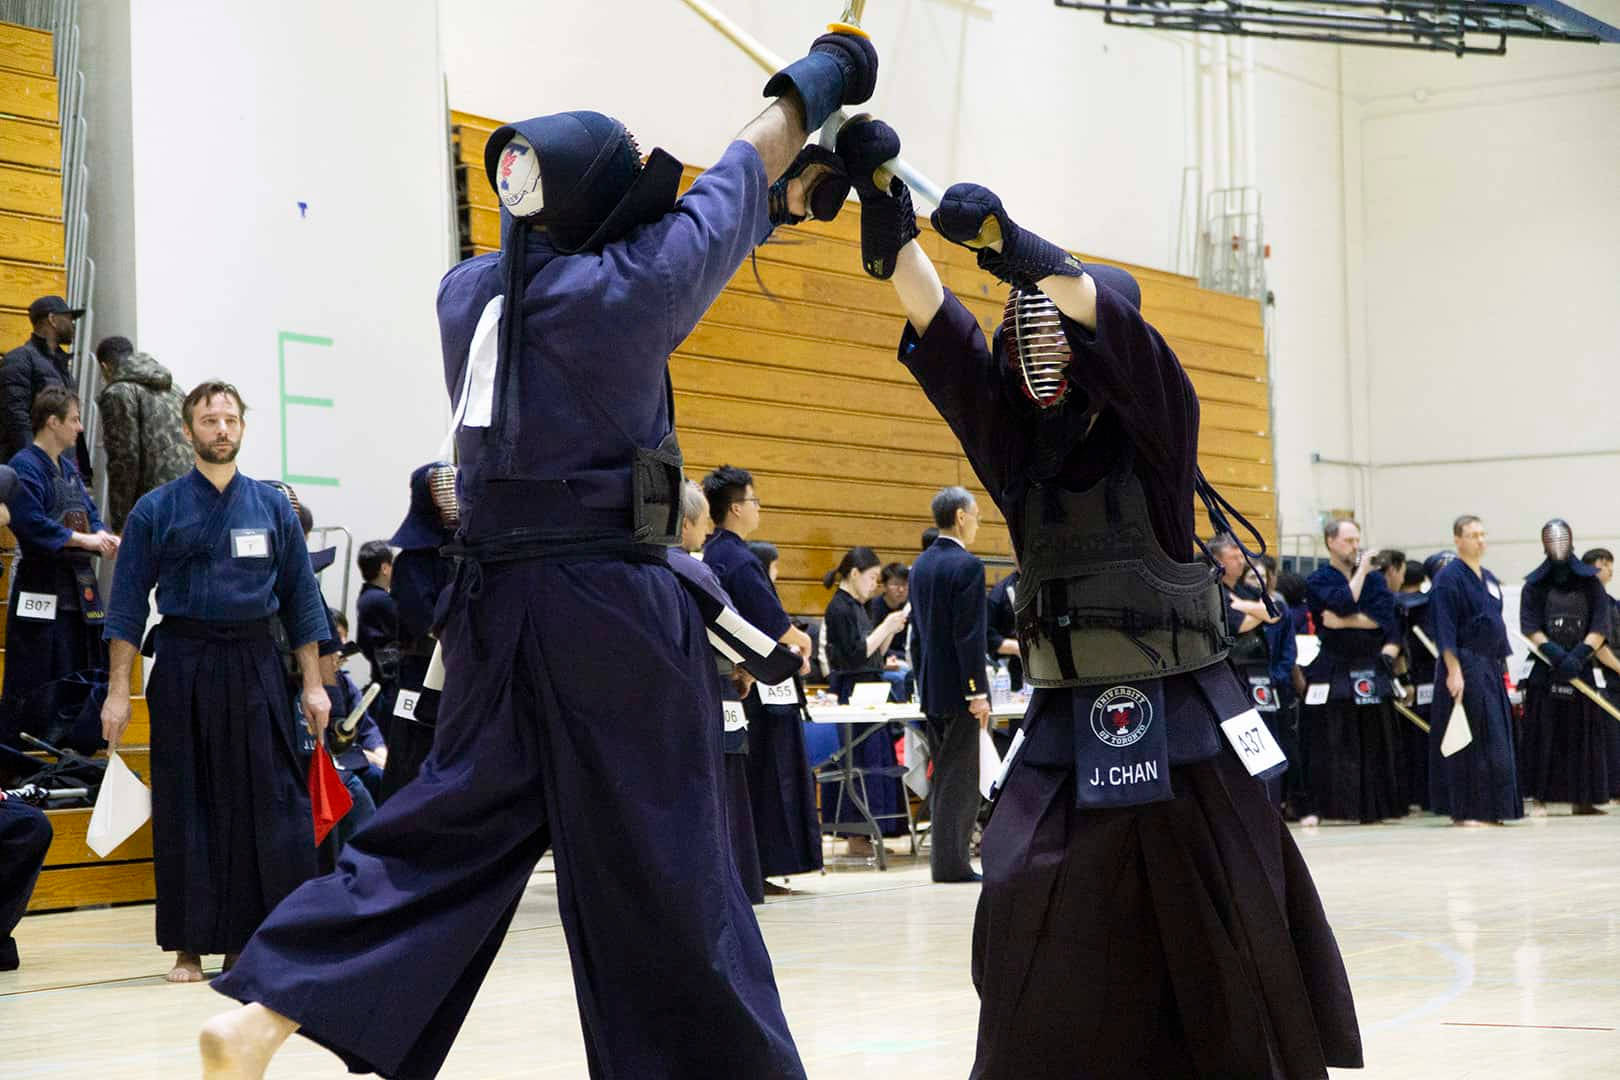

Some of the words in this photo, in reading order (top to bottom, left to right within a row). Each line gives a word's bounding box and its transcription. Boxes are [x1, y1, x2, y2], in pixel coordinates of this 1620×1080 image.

[278, 331, 340, 486] E
[24, 599, 51, 612] B07
[767, 685, 792, 697] A55
[1096, 688, 1145, 709] UNIVERSITY
[1100, 730, 1110, 740] OF
[1111, 724, 1146, 745] TORONTO
[1238, 727, 1267, 758] A37
[1090, 767, 1105, 786] J.
[1109, 760, 1158, 786] CHAN
